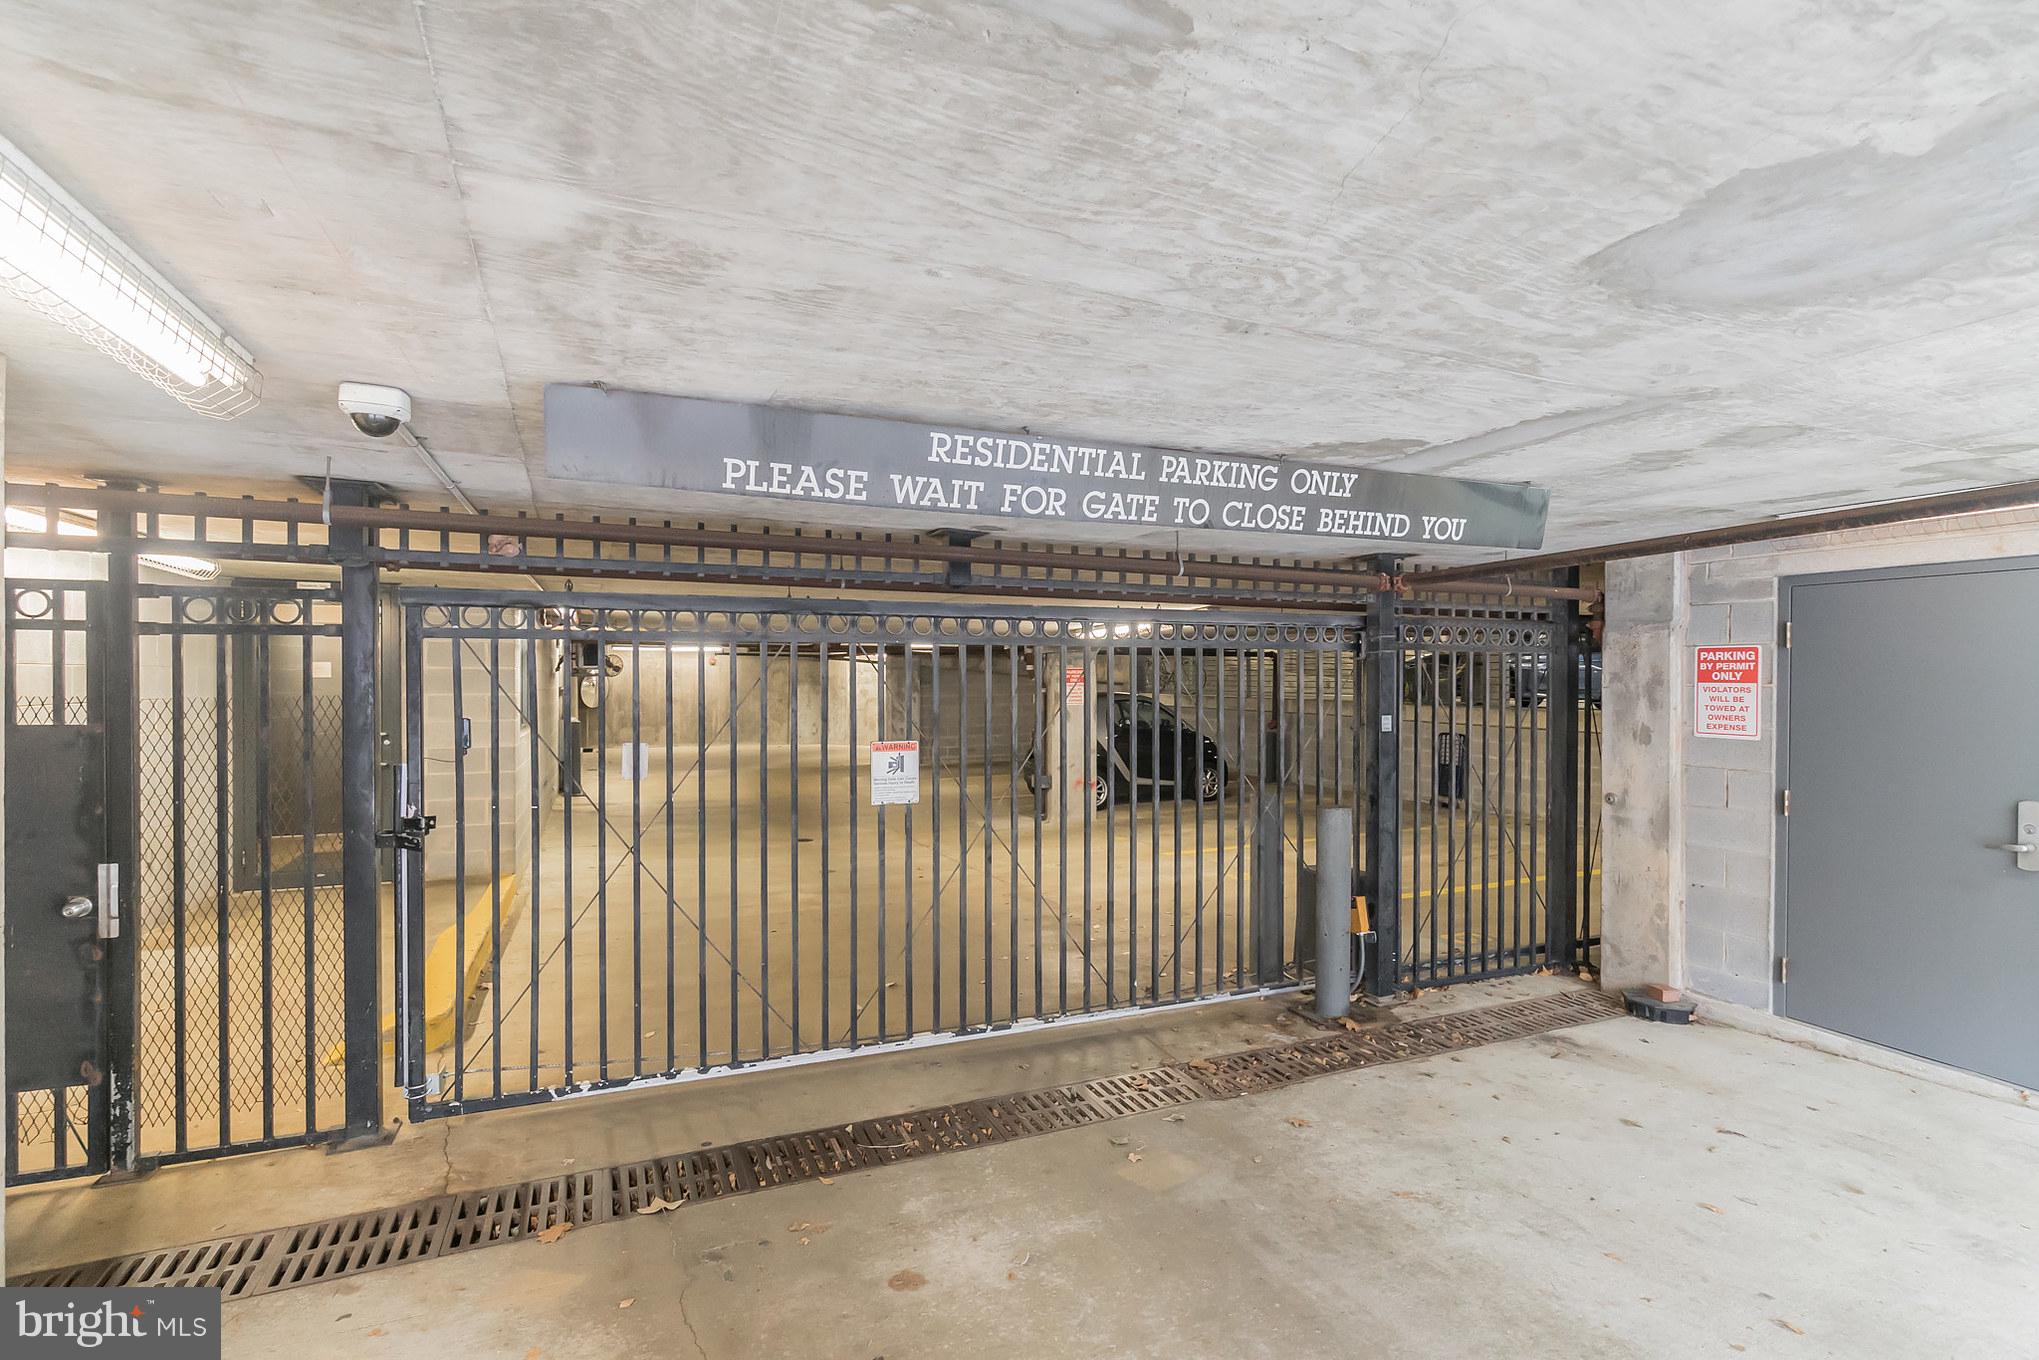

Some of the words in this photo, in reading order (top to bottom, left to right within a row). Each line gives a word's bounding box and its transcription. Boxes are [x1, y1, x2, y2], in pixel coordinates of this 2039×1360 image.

[927, 431, 1146, 481] RESIDENTIAL
[1158, 455, 1280, 492] PARKING
[1290, 468, 1359, 498] ONLY
[722, 457, 869, 501] PLEASE
[890, 474, 985, 510] WAIT
[1000, 484, 1067, 516] FOR
[1082, 490, 1160, 522] GATE
[1173, 497, 1211, 525] TO
[1222, 501, 1306, 531] CLOSE
[1316, 508, 1410, 539] BEHIND
[1421, 515, 1468, 541] YOU
[1700, 651, 1756, 661] PARKING
[1700, 662, 1714, 670] BY
[1716, 662, 1756, 670] PERMIT
[1712, 671, 1743, 681] ONLY
[1702, 686, 1752, 694] VIOLATORS
[1708, 695, 1730, 703] WILL
[1704, 704, 1736, 712] TOWED
[1707, 714, 1746, 722] OWNERS
[1706, 723, 1747, 731] EXPENSE
[881, 743, 916, 751] WARNING
